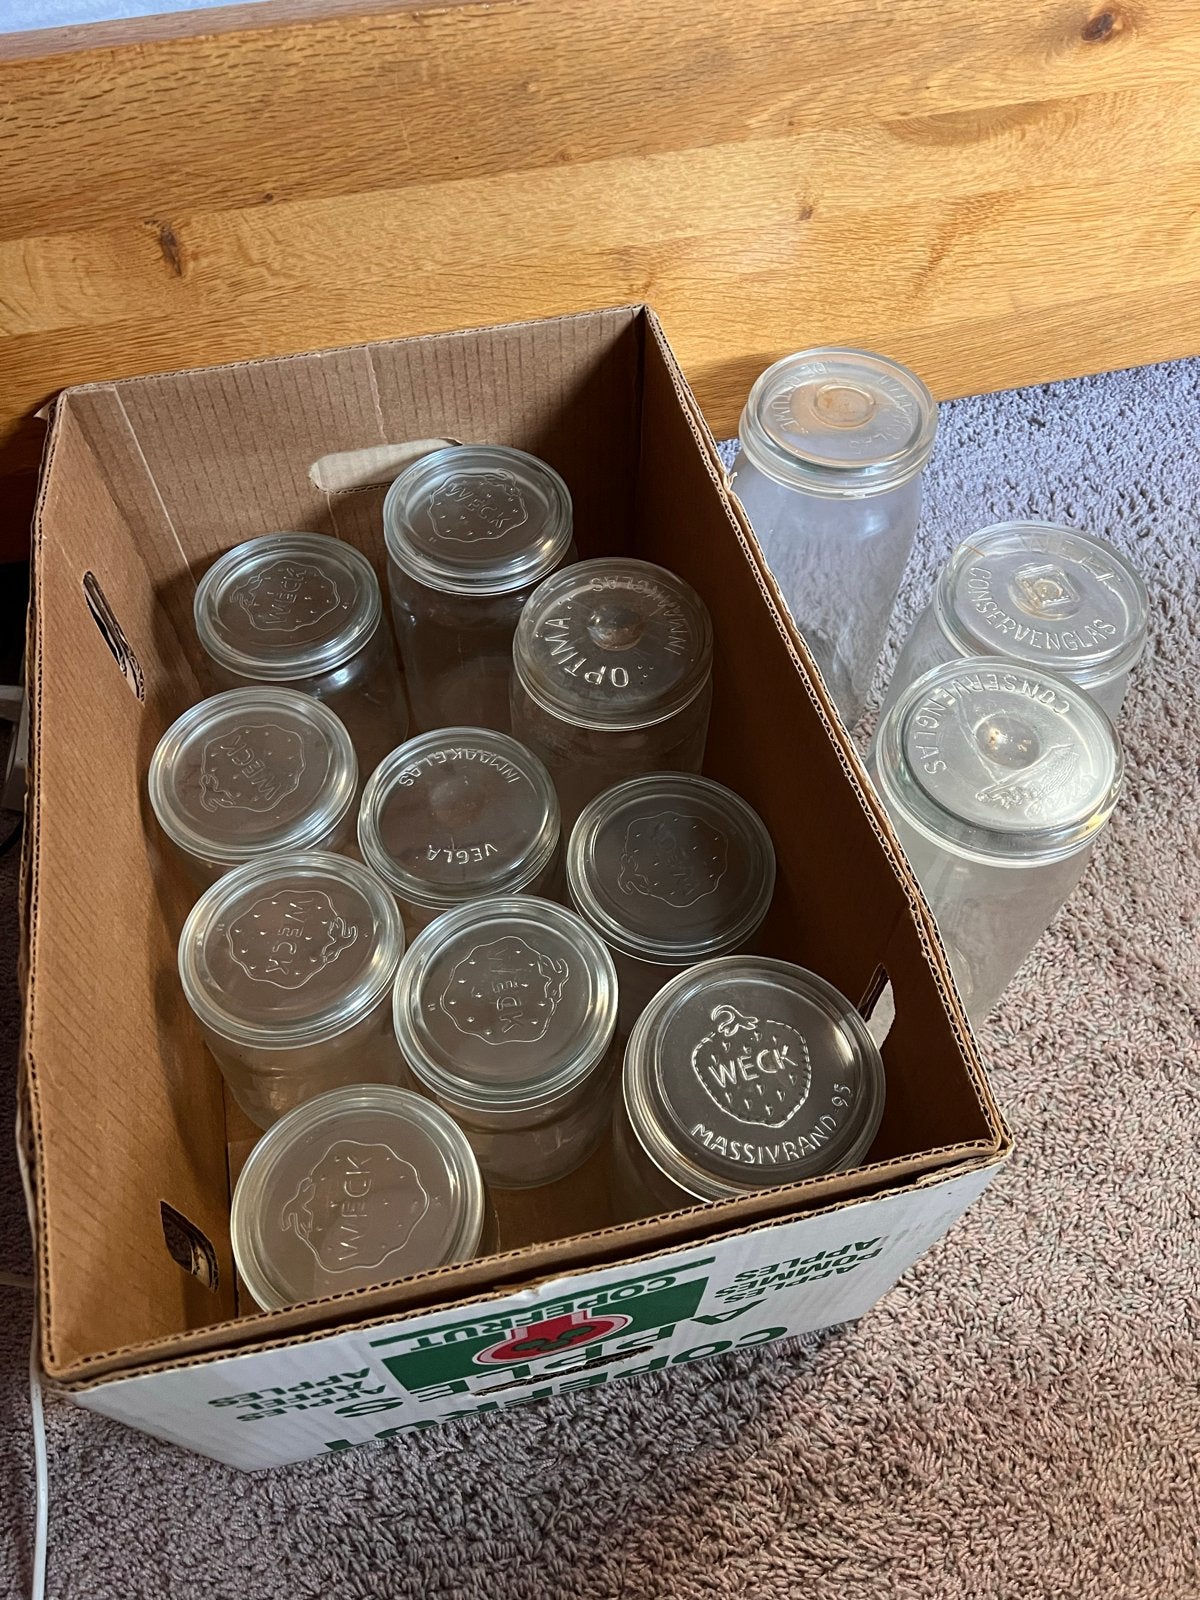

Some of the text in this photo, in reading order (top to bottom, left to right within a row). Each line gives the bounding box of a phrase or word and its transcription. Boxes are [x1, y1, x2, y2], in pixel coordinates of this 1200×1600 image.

[446, 482, 512, 528] WECK
[266, 567, 307, 623] WECK
[967, 566, 1116, 651] CONSERVENGLAS
[544, 617, 630, 688] OPTIMA
[915, 673, 1071, 775] CONSERVENGLAS
[221, 734, 282, 801] WECK
[398, 747, 521, 788] INMAAKGLAS
[426, 842, 499, 866] VEGLA
[265, 898, 315, 976] WECK
[487, 949, 528, 1034] WECK
[707, 1044, 798, 1089] WECK
[690, 1114, 838, 1165] MASSIVRAND
[338, 1155, 373, 1262] WECK
[714, 1247, 884, 1299] POMMES
[723, 1262, 861, 1305] APPLES
[734, 1236, 883, 1283] APPLES
[410, 1275, 677, 1351] COPEFRUT
[334, 1297, 768, 1418] APPLES
[207, 1367, 371, 1408] APPLES
[236, 1383, 387, 1422] APPLES
